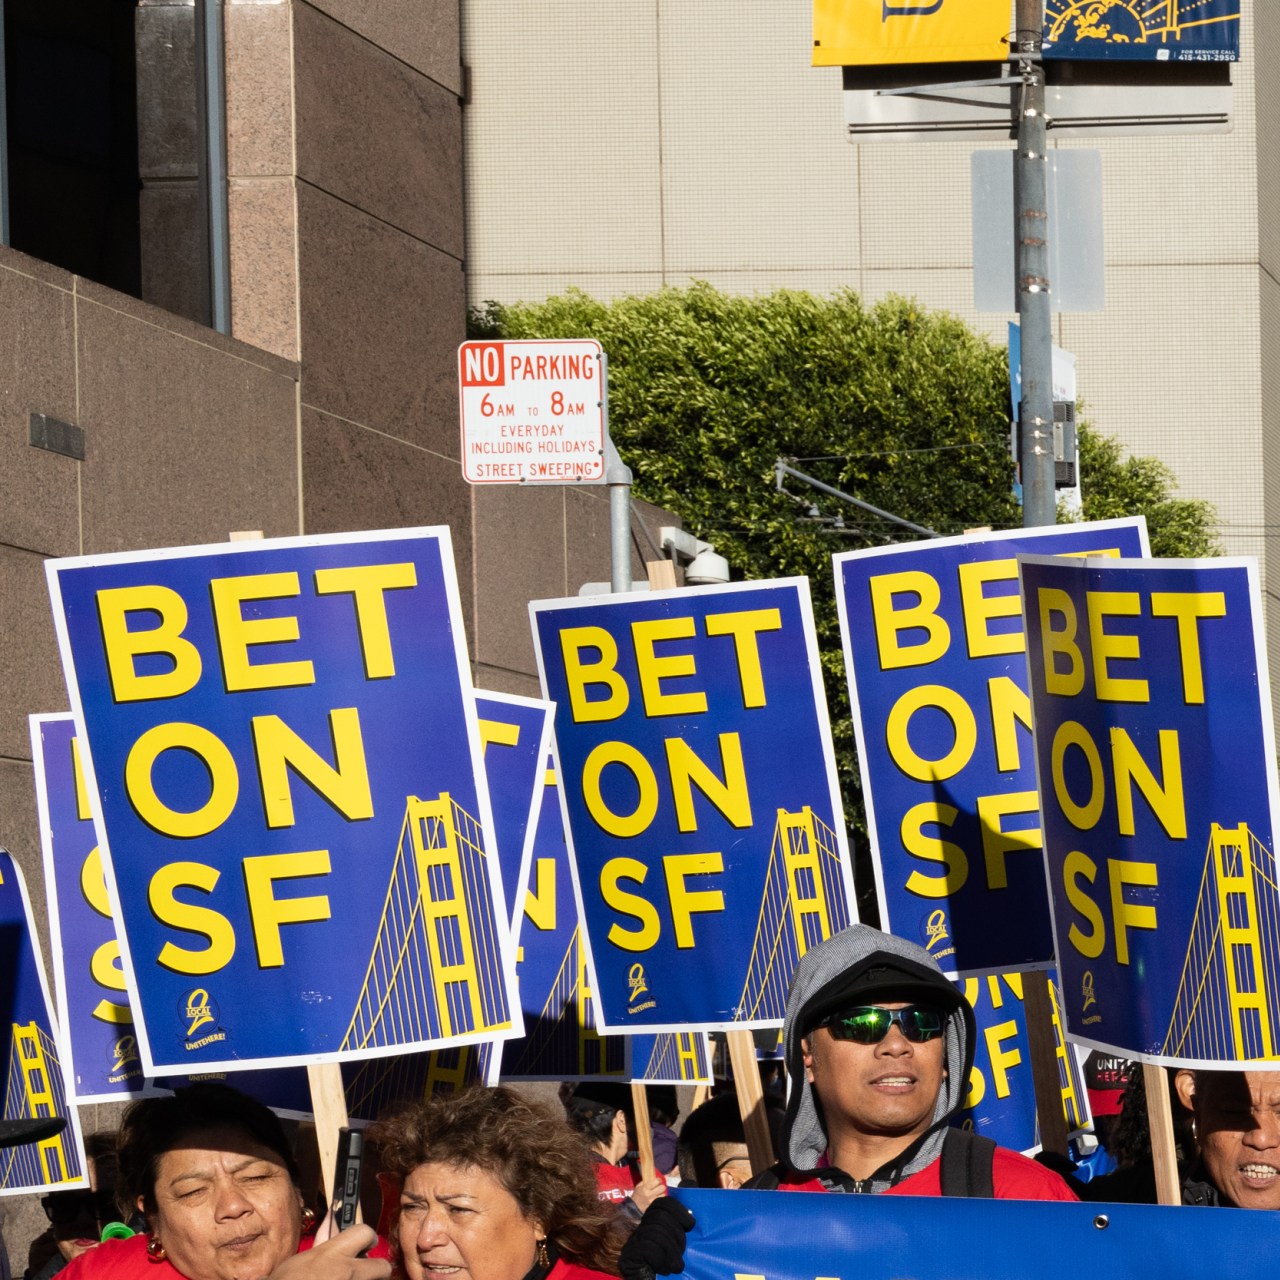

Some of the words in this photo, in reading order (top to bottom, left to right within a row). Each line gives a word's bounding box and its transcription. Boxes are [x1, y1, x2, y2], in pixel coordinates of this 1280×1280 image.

[465, 346, 500, 382] NO
[510, 354, 594, 380] PARKING
[528, 407, 539, 416] TO
[471, 442, 532, 454] INCLUDING
[538, 441, 595, 453] HOLIDAYS
[476, 463, 523, 476] STREET
[529, 462, 593, 476] SWEEPING
[500, 425, 565, 437] EVERYDAY
[97, 562, 417, 703] BET
[560, 608, 782, 723] BET
[1038, 587, 1226, 704] BET
[125, 708, 374, 838] ON
[582, 732, 752, 838] ON
[1052, 721, 1188, 840] ON
[900, 791, 1042, 898] SF
[148, 850, 331, 975] SF
[600, 851, 724, 952] SF
[1063, 850, 1159, 966] SF
[185, 1033, 226, 1051] UNITEHERE!
[186, 1006, 211, 1017] LOCAL
